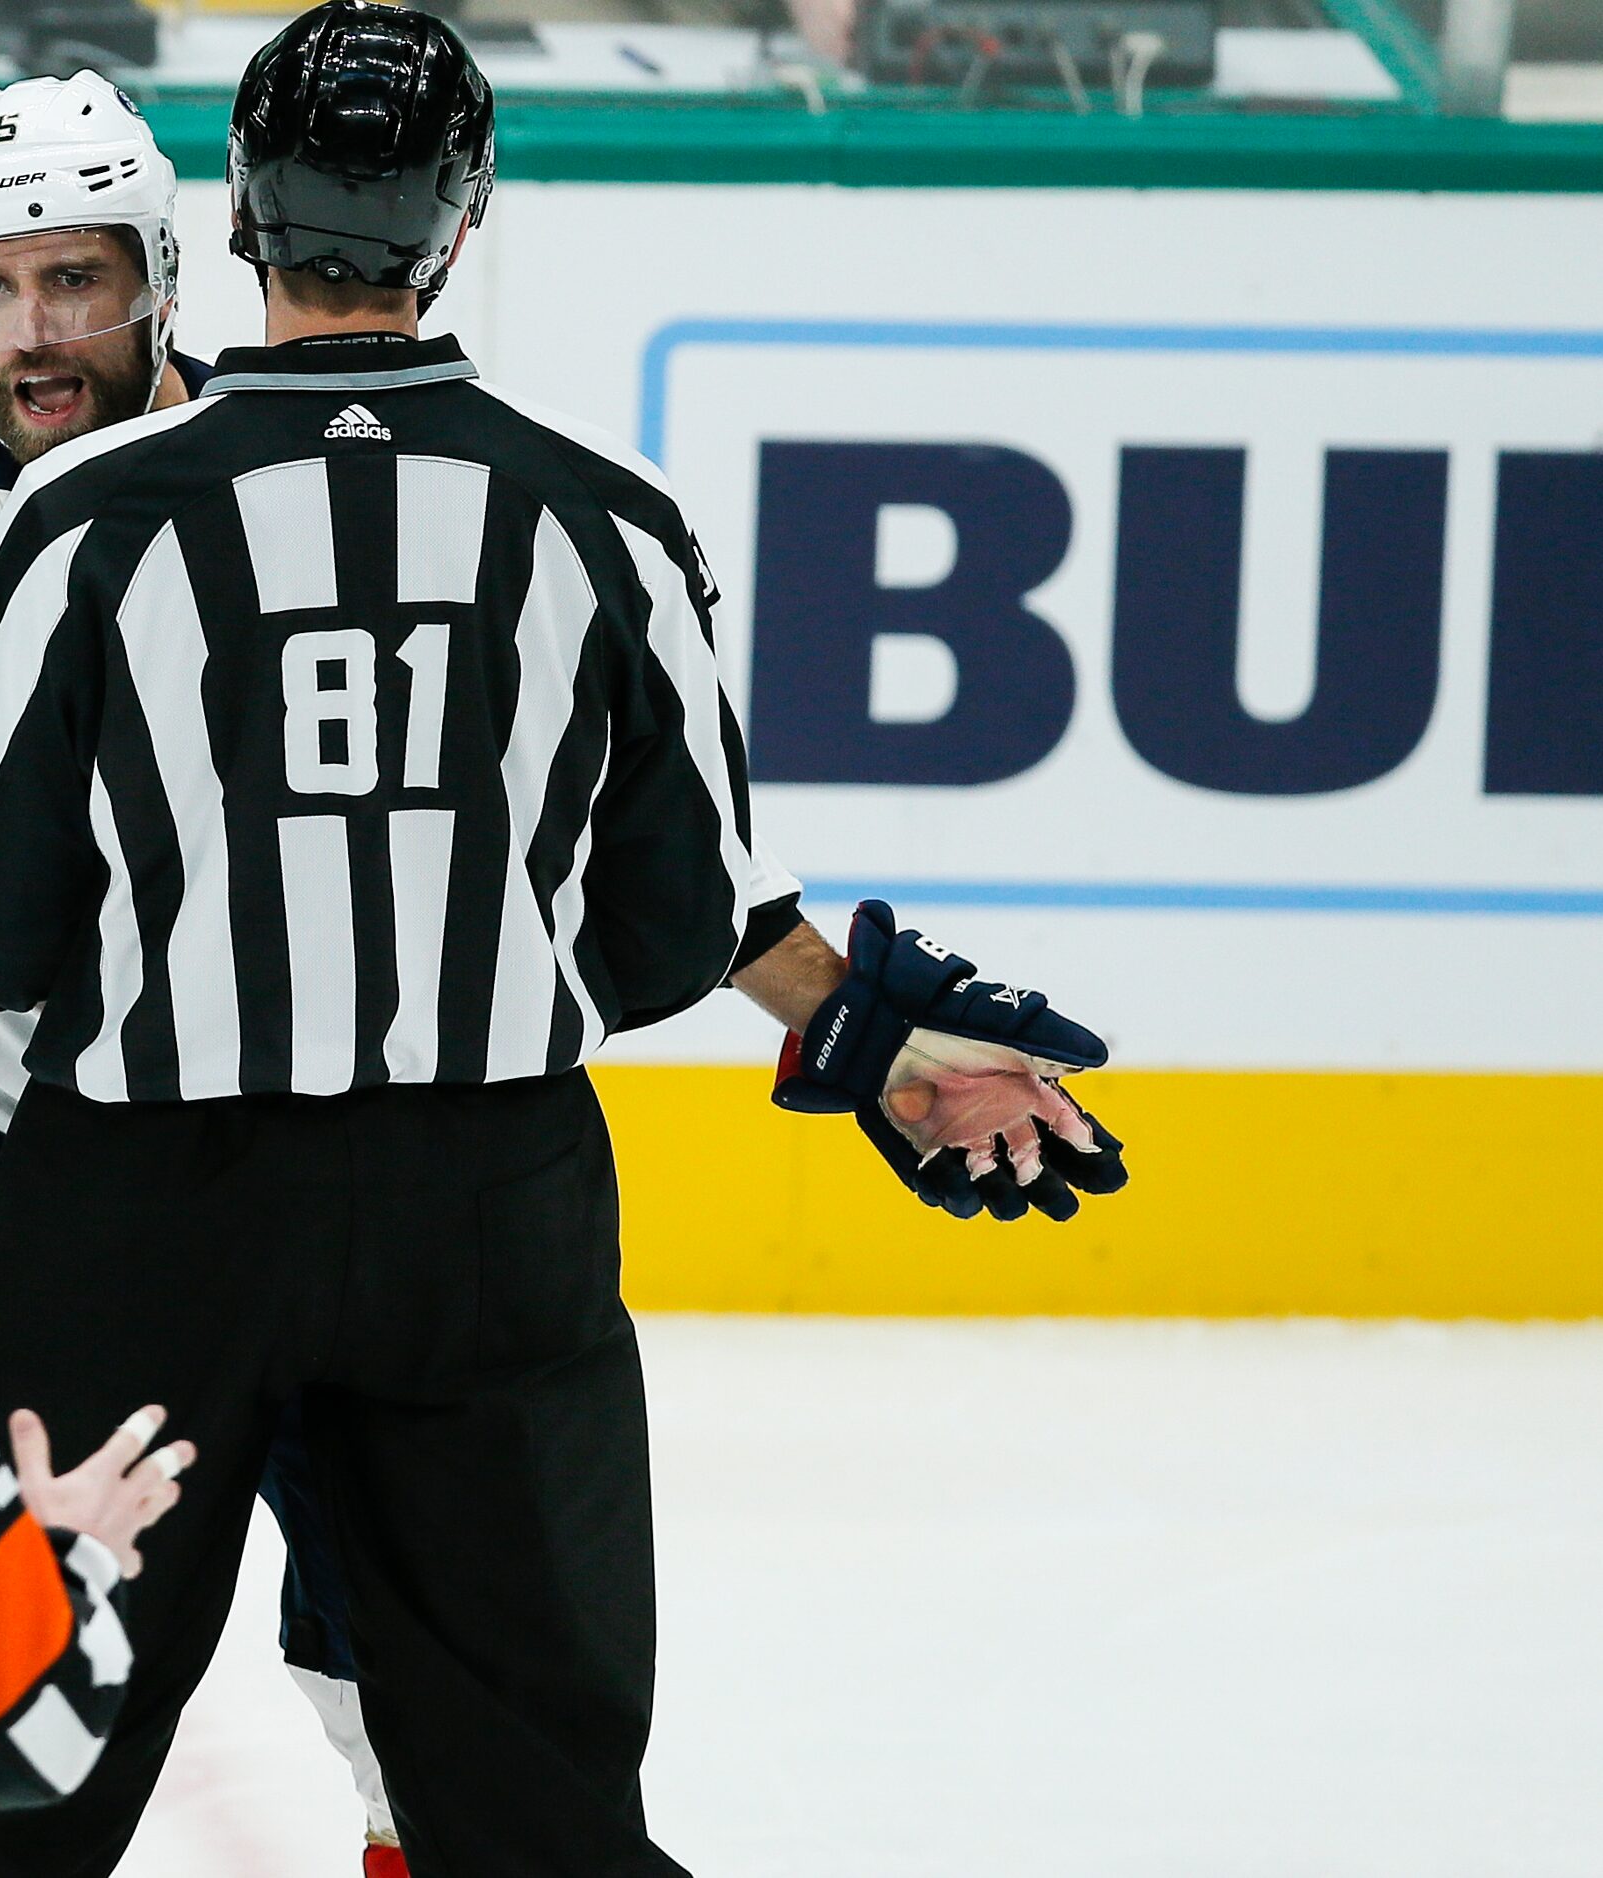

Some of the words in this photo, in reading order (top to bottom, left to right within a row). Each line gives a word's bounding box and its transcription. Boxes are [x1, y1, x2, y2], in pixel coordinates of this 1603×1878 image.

[323, 423, 393, 441] adidas
[281, 623, 451, 797] 81
[816, 1004, 850, 1070] BAUER
